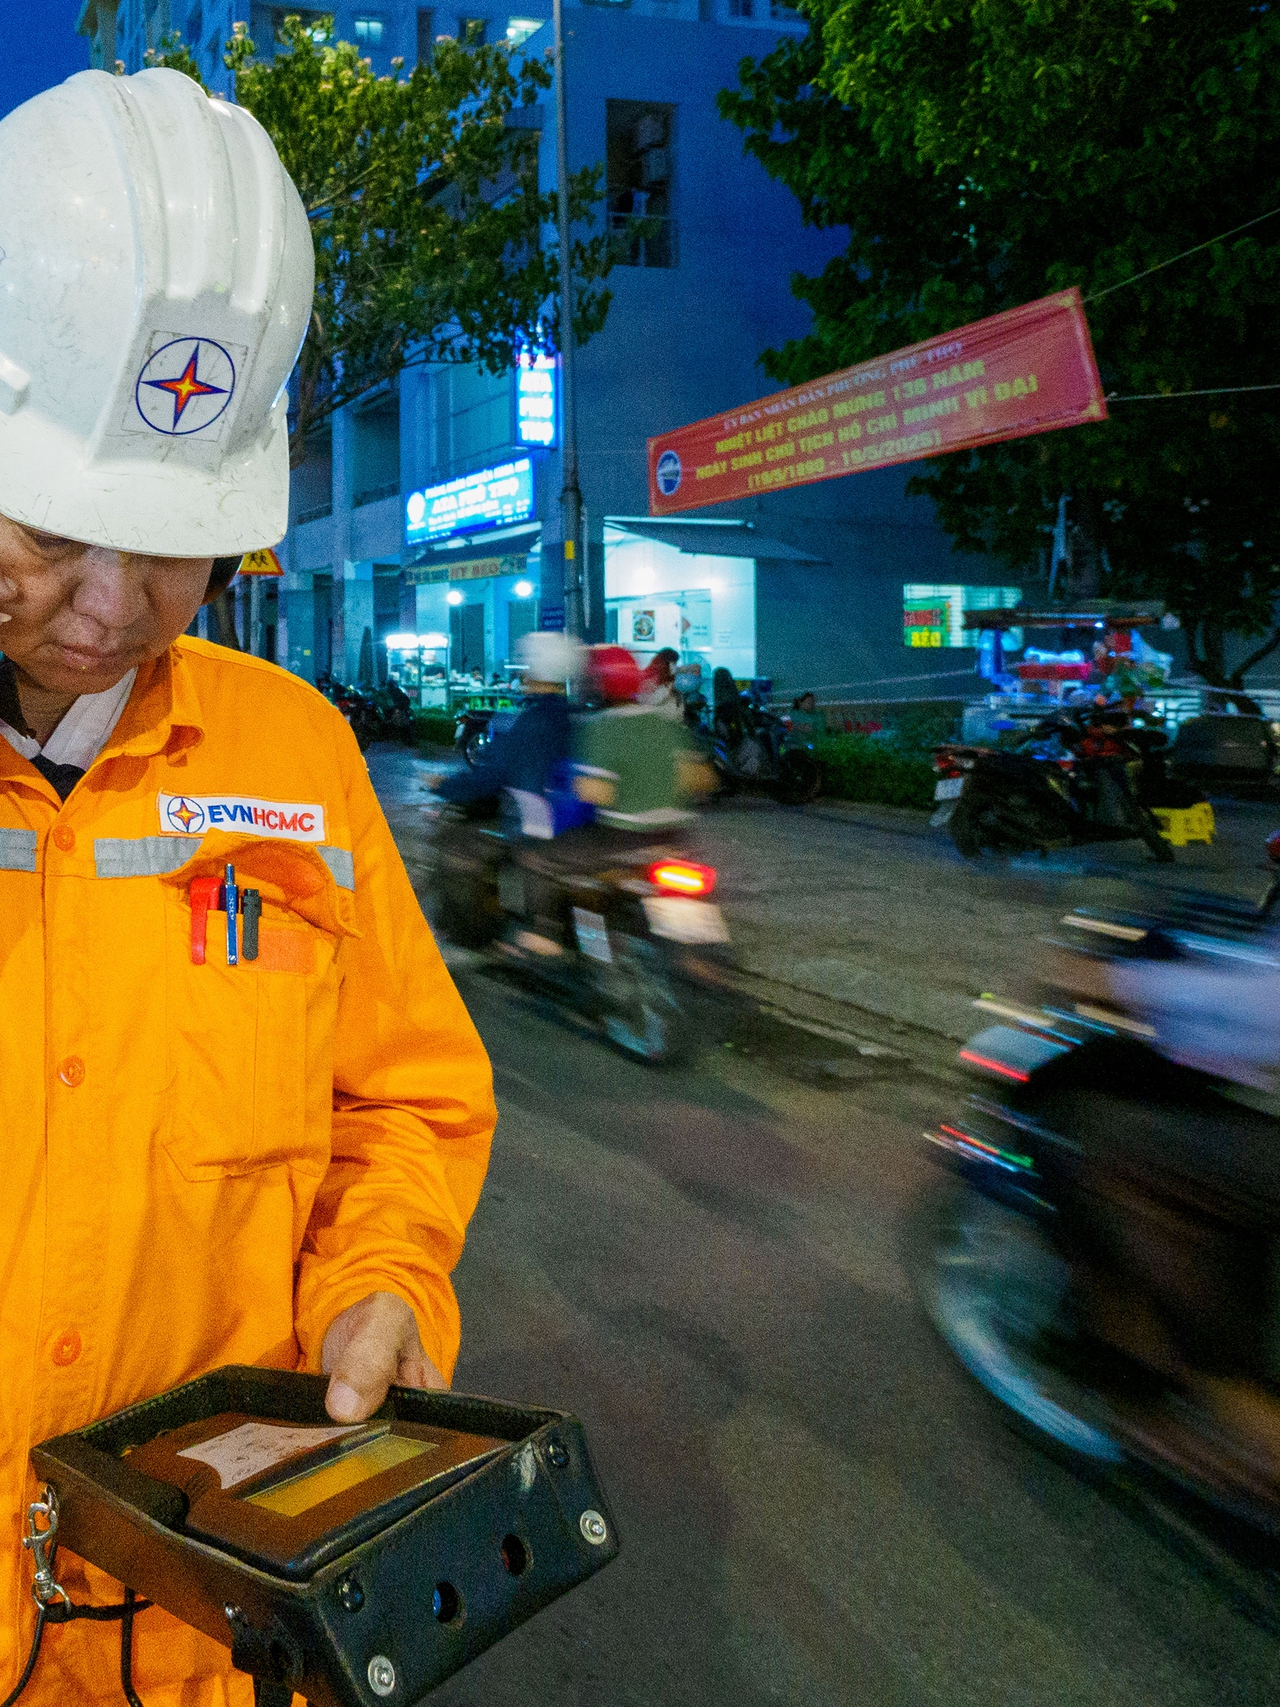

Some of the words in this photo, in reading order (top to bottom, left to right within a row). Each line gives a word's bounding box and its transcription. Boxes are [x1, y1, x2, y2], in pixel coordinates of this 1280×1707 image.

[730, 450, 764, 472] SINH
[902, 396, 960, 427] MINH
[787, 407, 830, 433] CHÀO
[207, 804, 316, 833] EVNHCMC
